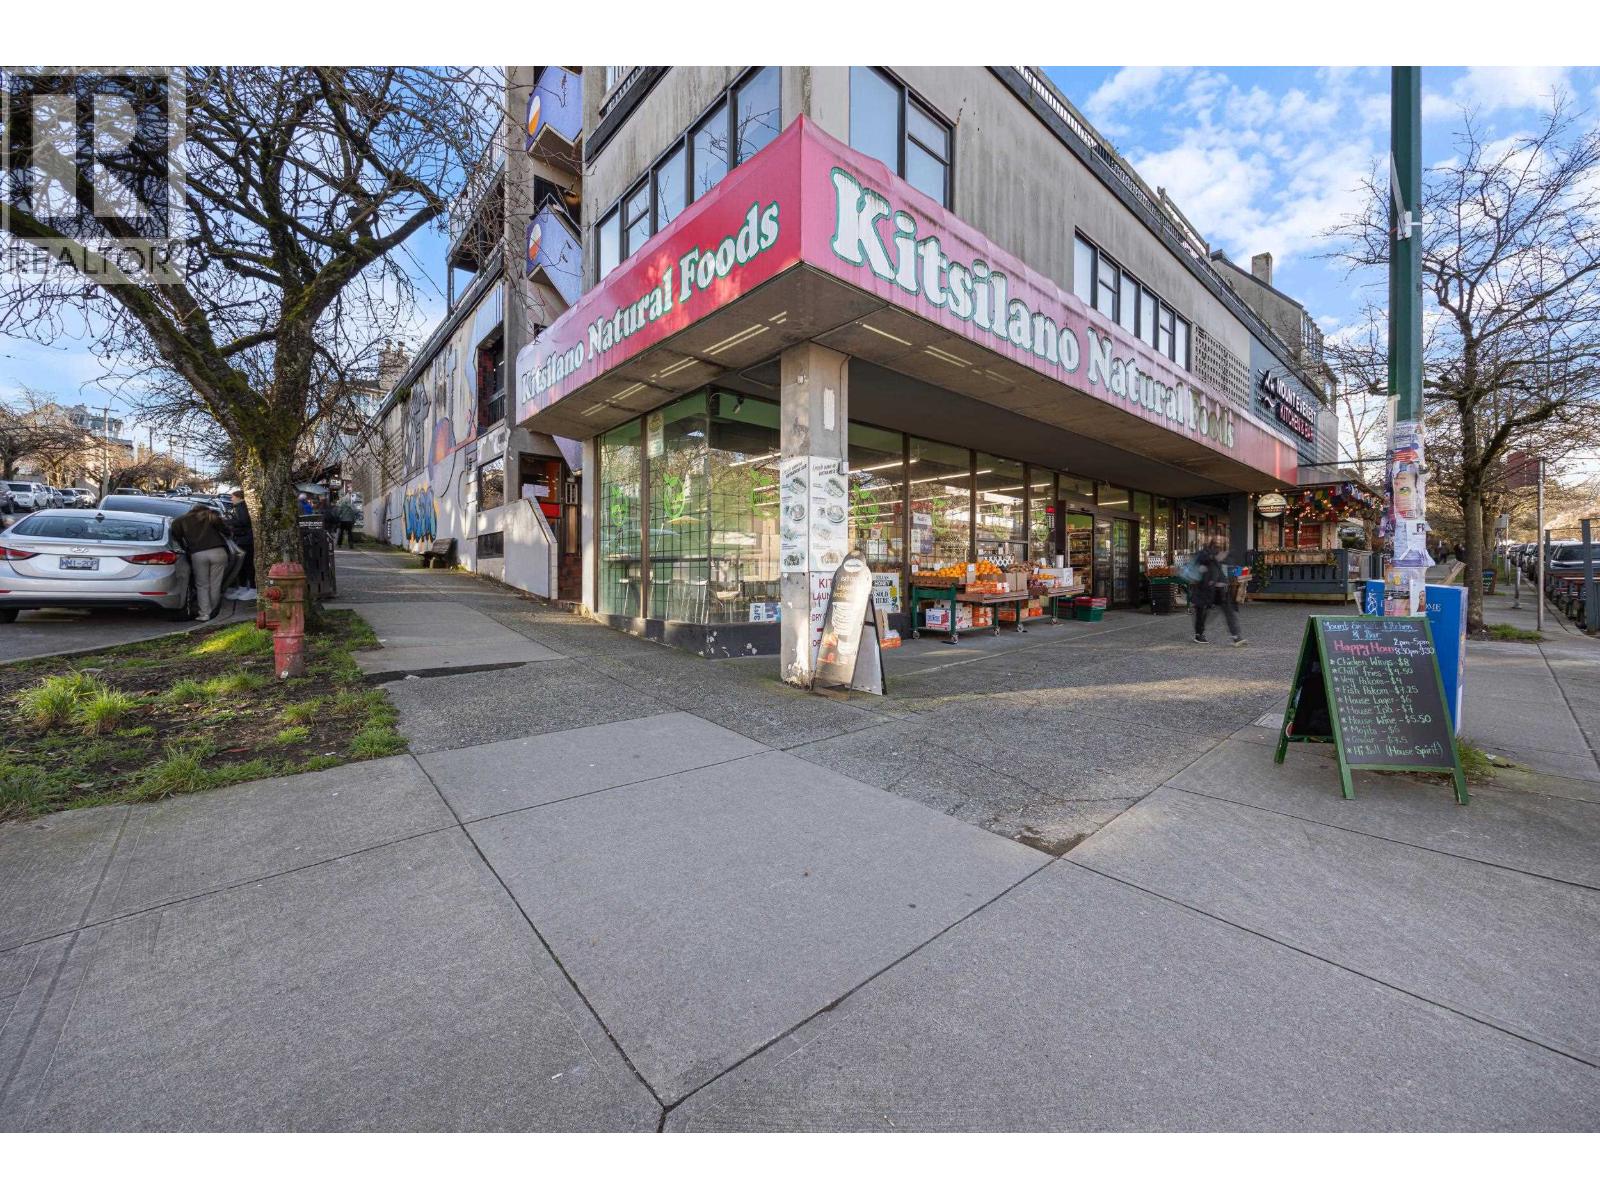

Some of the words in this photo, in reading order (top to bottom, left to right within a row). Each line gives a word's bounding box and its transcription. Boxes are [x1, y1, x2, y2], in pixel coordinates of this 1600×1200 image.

[520, 340, 584, 404] Kitsilano
[588, 266, 673, 362] Natural
[678, 200, 780, 303] Foods
[830, 166, 1081, 373] Kitsilano
[1087, 326, 1184, 426] Natural
[1276, 377, 1295, 408] MOUNT
[1334, 640, 1369, 656] Happy
[1337, 656, 1367, 666] Chicken
[1369, 656, 1393, 670] Wings
[1344, 695, 1370, 705] House
[1346, 705, 1372, 715] House
[1376, 713, 1397, 725] Wine
